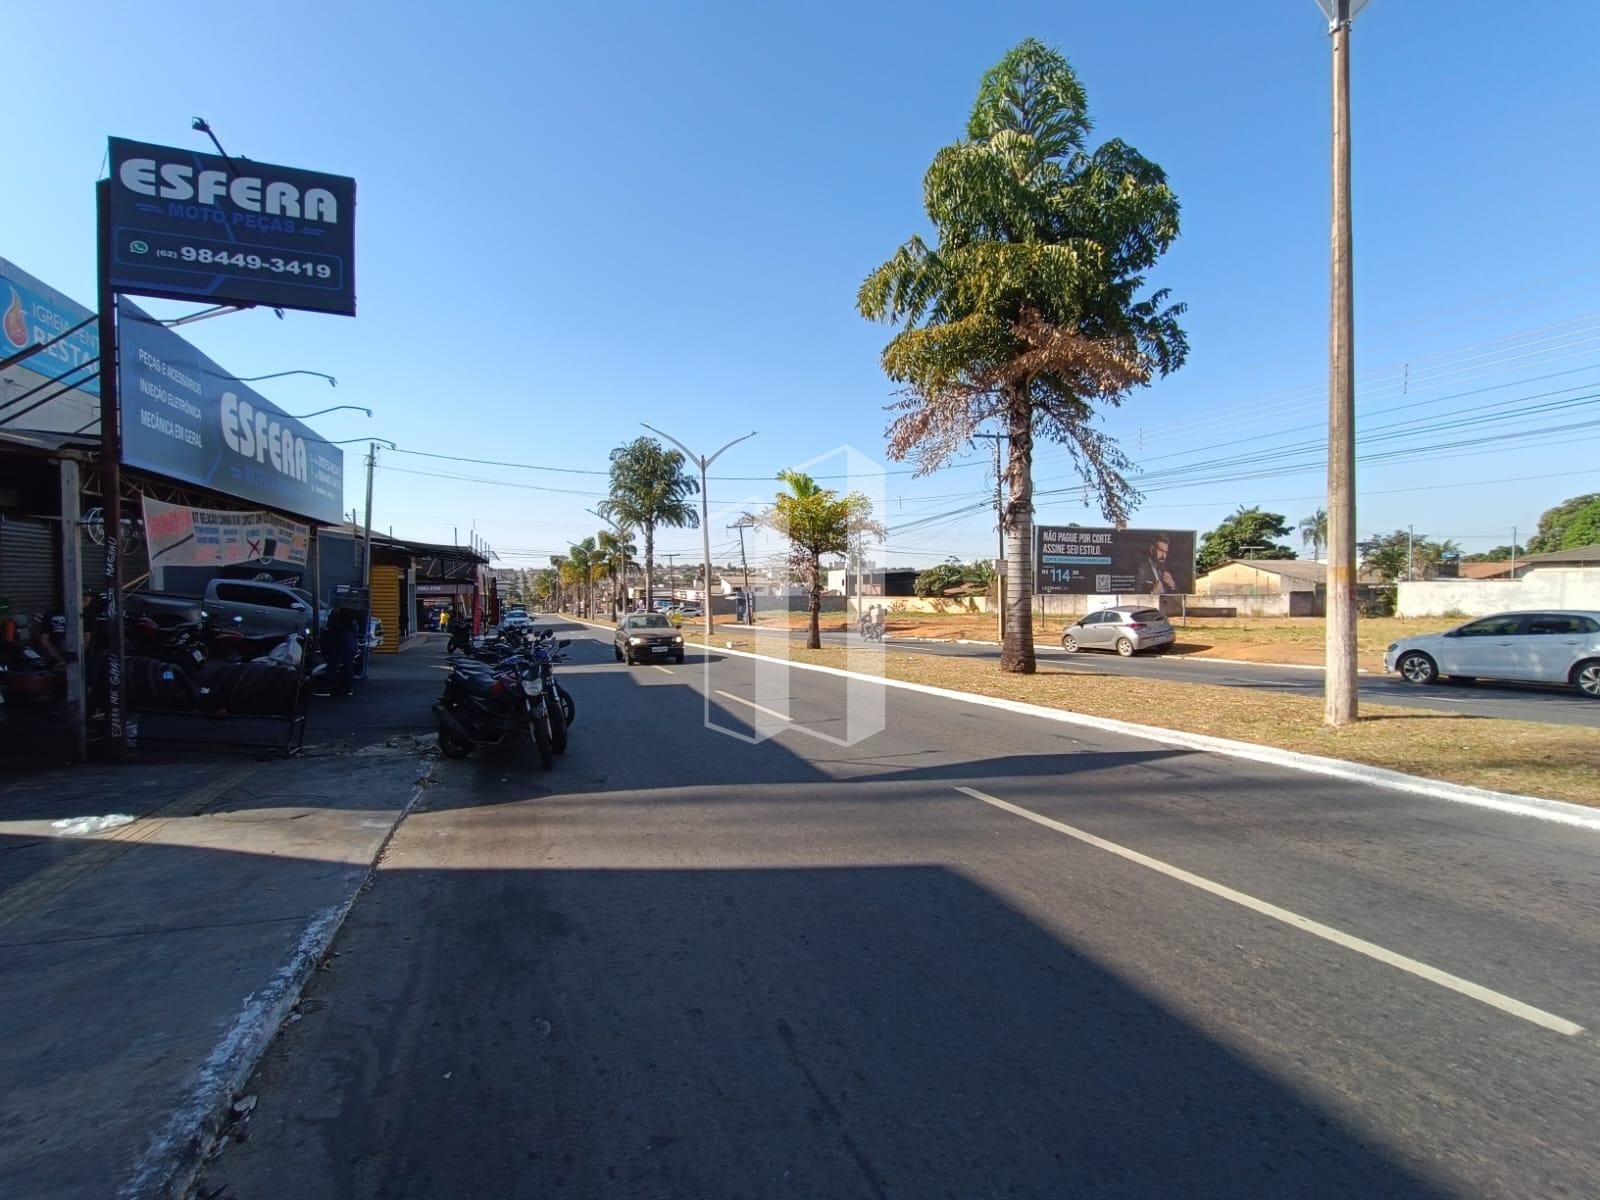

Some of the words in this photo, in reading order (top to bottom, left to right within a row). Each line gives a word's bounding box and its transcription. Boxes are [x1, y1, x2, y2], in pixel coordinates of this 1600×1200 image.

[120, 158, 337, 224] ESFERA
[168, 203, 225, 222] MOTO
[232, 213, 295, 234] PEÇAS
[156, 248, 178, 260] (62)
[181, 246, 331, 279] 98449-3419
[138, 348, 161, 373] PEÇAS
[161, 362, 167, 376] E
[139, 377, 167, 403] INJEÇÃO
[167, 392, 202, 421] ELETRÔNICA
[140, 408, 174, 437] MECÂNICA
[174, 423, 184, 440] EM
[184, 428, 203, 449] GERAL
[221, 391, 307, 483] ESFERA
[1042, 543, 1066, 554] ASSINE
[1066, 544, 1078, 554] SEU
[1079, 545, 1102, 555] ESTILO.
[1043, 530, 1057, 542] NÃO
[1057, 532, 1078, 543] PAGUE
[1078, 533, 1091, 543] POR
[1092, 533, 1113, 544] CORTE.
[1050, 568, 1071, 582] 114
